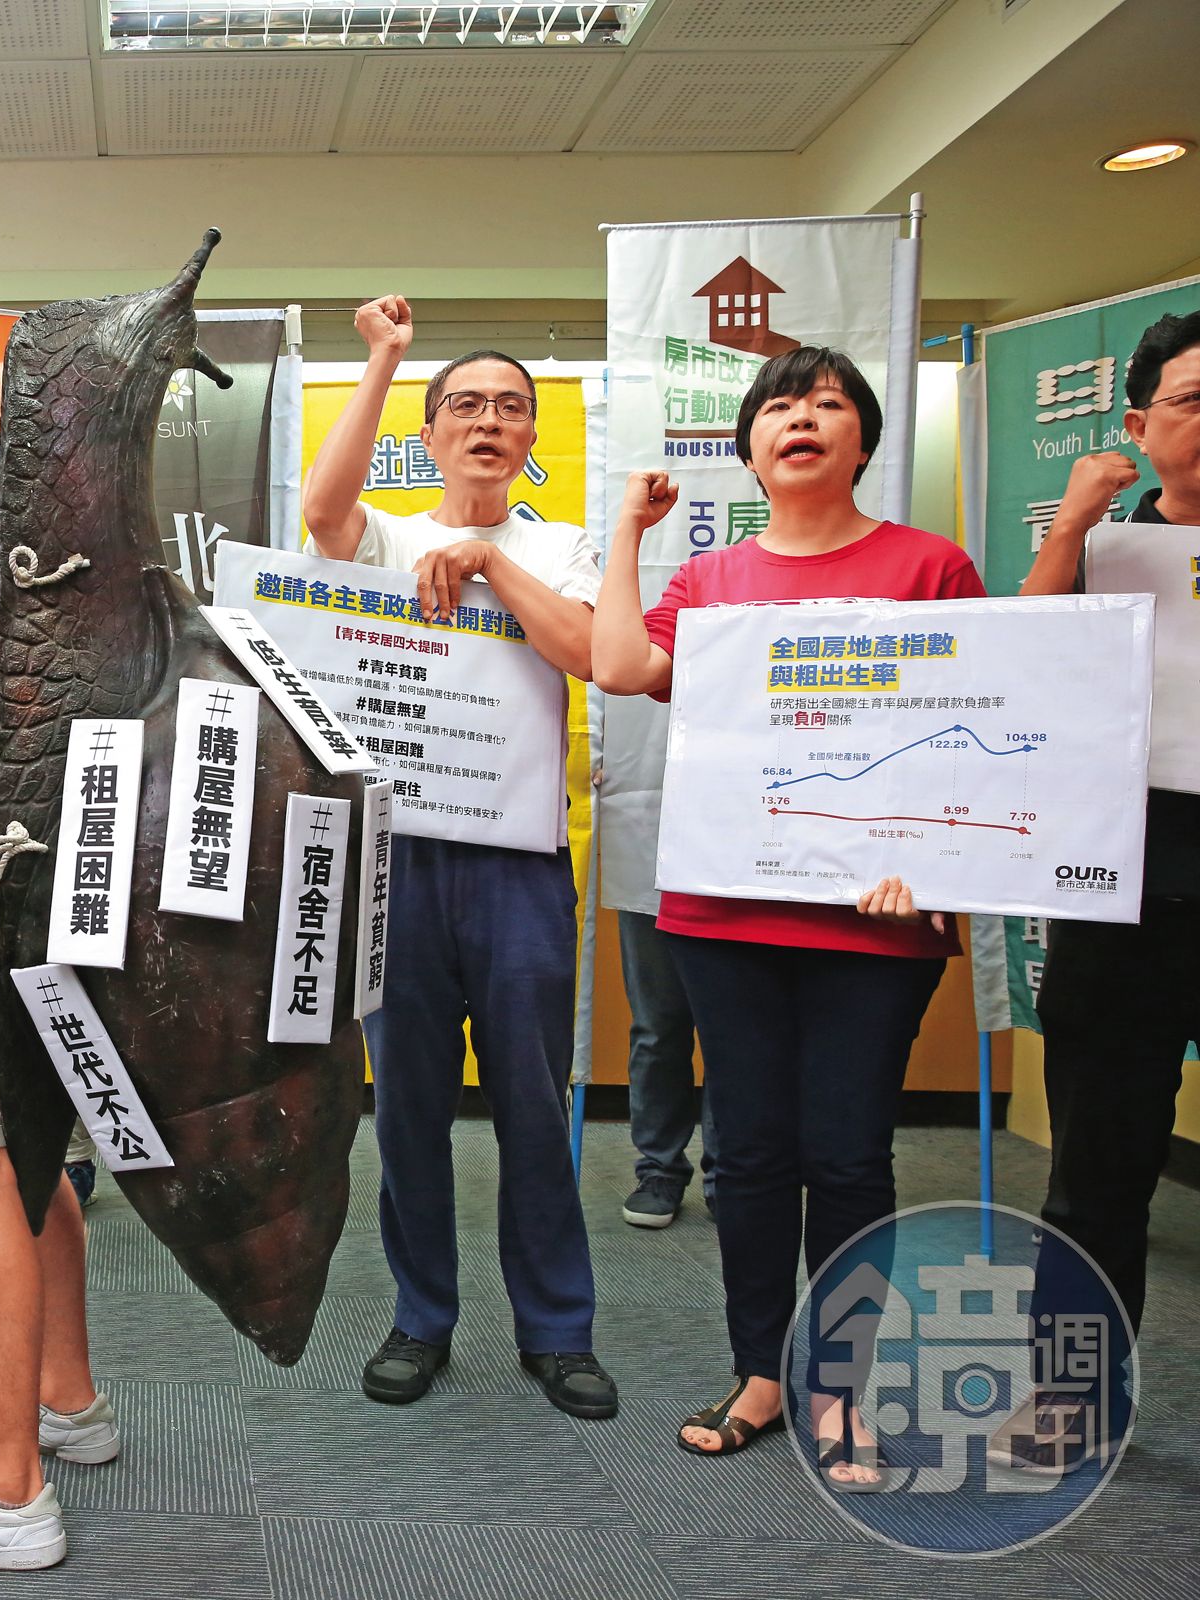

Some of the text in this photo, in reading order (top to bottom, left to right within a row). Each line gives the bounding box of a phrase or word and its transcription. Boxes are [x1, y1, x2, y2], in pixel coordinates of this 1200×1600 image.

[664, 386, 742, 424] 行動聯
[664, 441, 736, 457] HOUSIN
[1032, 424, 1132, 460] Youth Labo
[689, 501, 715, 558] HO
[771, 632, 954, 660] 全國房地產指數
[357, 657, 428, 682] #青年貧窮
[770, 663, 898, 686] 與粗出生率
[356, 696, 427, 720] #購屋無望
[770, 696, 1005, 710] 研究指出全國總生育率與房屋貸款負擔率
[770, 711, 852, 727] 呈現負向關係
[929, 740, 968, 749] 122.29
[1005, 733, 1047, 742] 104.98
[808, 752, 871, 761] 全國房地產指數
[368, 755, 502, 782] 市化，如何讓租屋有品質與保障?
[762, 767, 792, 776] 66.84
[187, 687, 239, 892] #購屋無望
[761, 796, 790, 805] 13.76
[943, 806, 970, 814] 8.99
[1009, 812, 1037, 821] 7.70
[70, 724, 118, 936] #租屋困難
[1055, 865, 1118, 882] OURs
[1056, 879, 1117, 891] 都市改革組織
[368, 790, 390, 992] #青年貧窮
[287, 803, 334, 1016] #宿舍不足
[36, 976, 151, 1161] #世代不公
